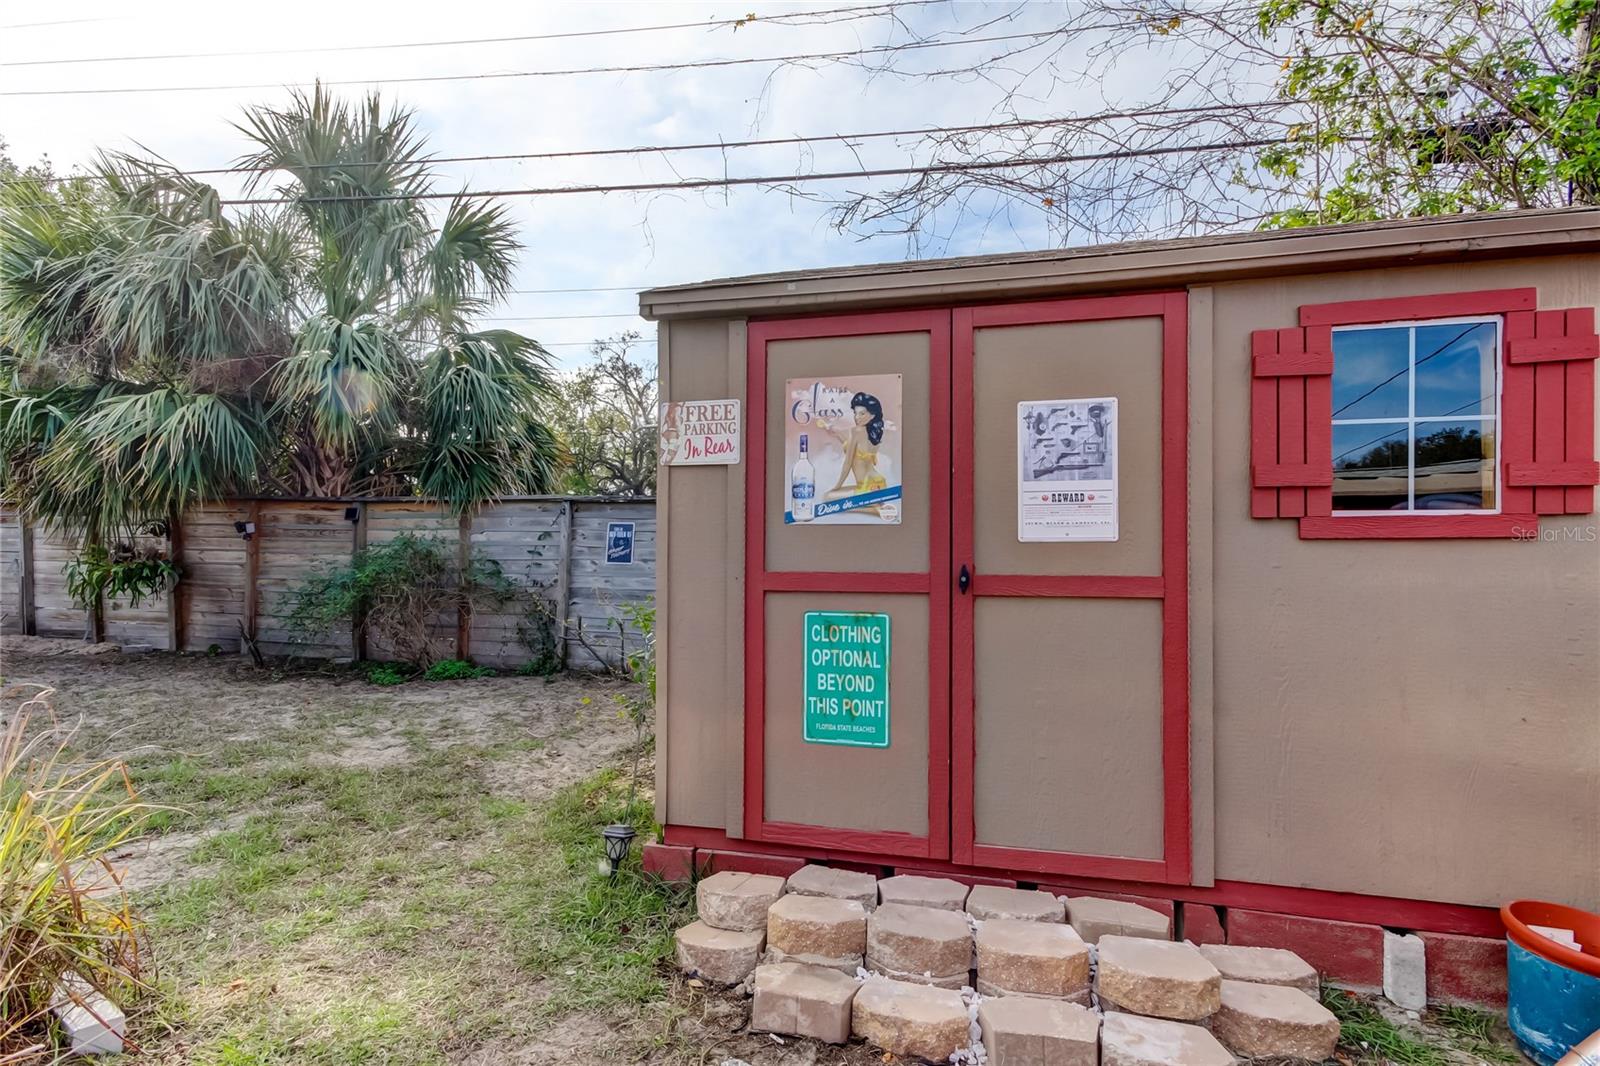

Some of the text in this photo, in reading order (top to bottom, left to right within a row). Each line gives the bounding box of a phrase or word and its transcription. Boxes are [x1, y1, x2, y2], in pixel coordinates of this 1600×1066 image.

[685, 404, 736, 422] FREE
[792, 382, 844, 425] Glass
[684, 422, 737, 436] PARKING
[684, 436, 735, 460] In Rear
[1051, 493, 1085, 502] REWARD
[817, 503, 841, 515] Dive
[811, 624, 882, 644] CLOTHING
[811, 648, 881, 668] OPTIONAL
[817, 673, 875, 692] BEYOND
[808, 697, 884, 718] THIS POINT
[837, 724, 851, 732] STATE
[852, 725, 876, 733] BEACHES
